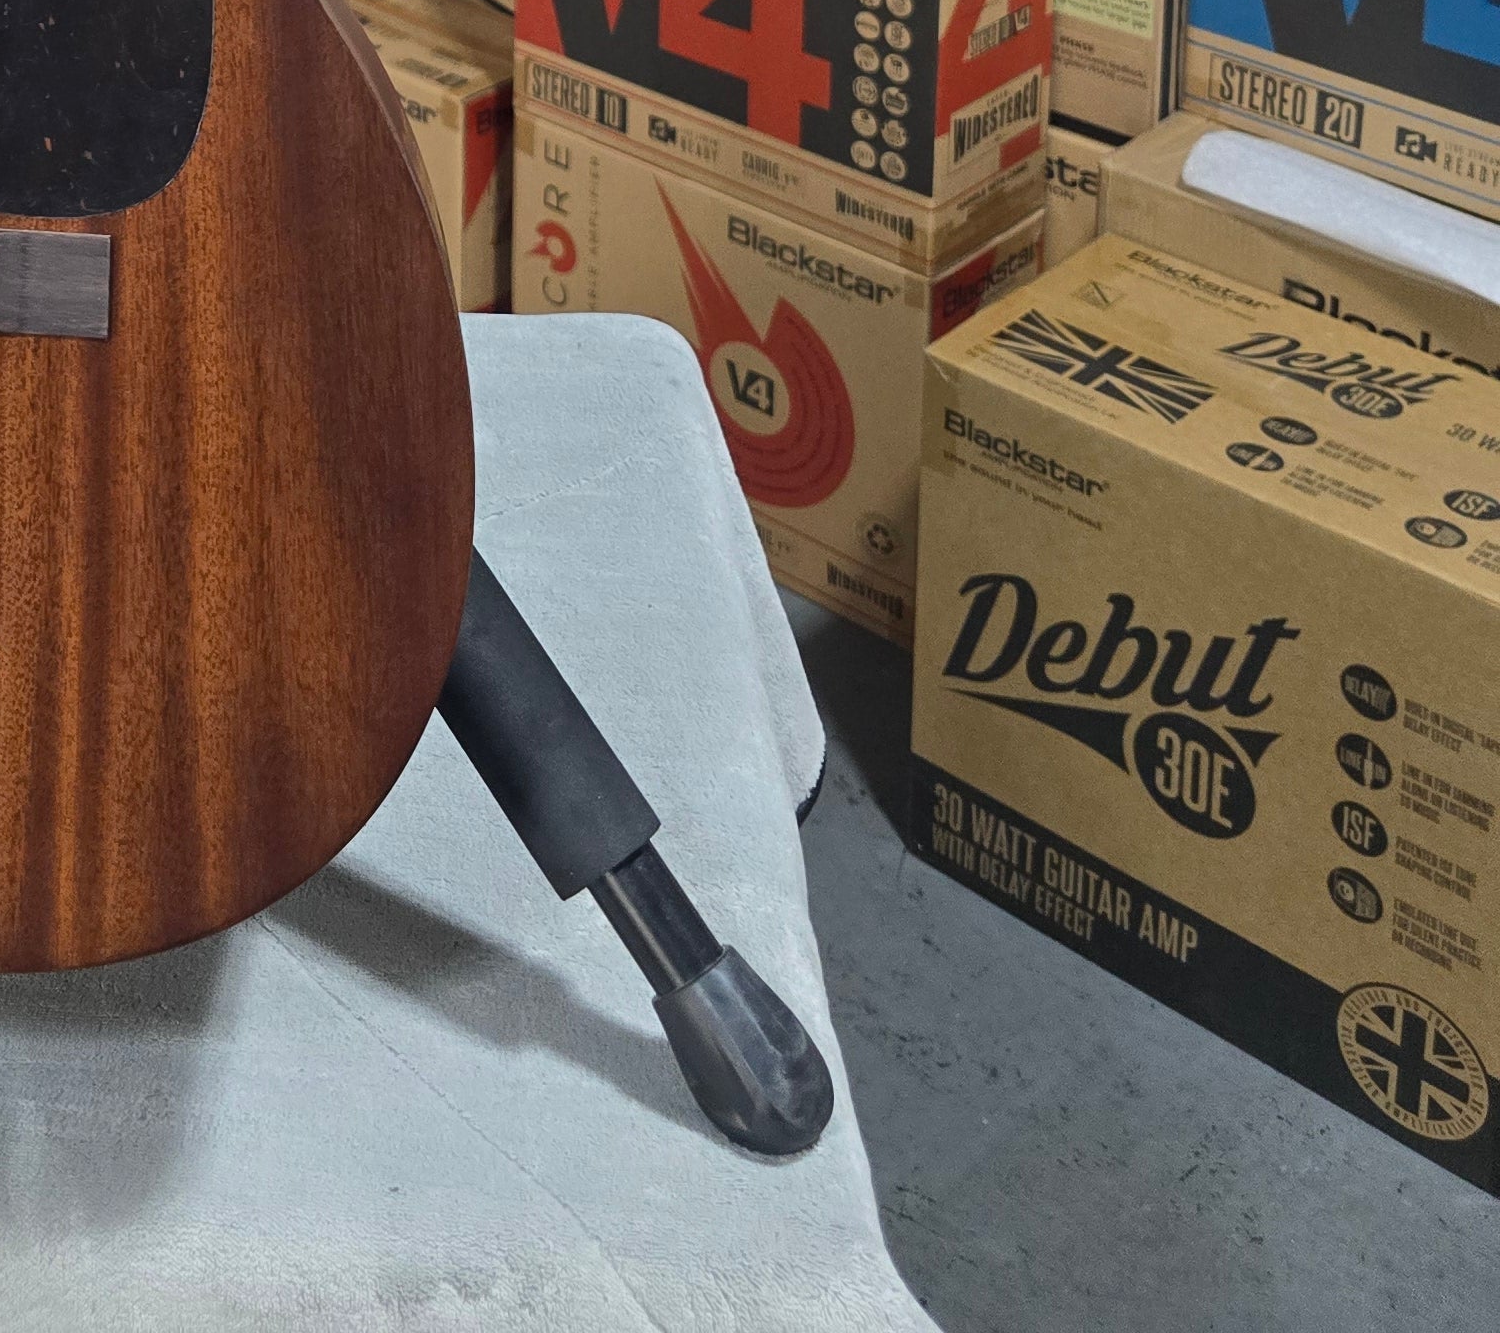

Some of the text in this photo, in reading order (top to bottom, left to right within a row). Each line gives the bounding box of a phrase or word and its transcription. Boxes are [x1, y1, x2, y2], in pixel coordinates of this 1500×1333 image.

[531, 65, 590, 119] STEREO
[1220, 60, 1358, 143] STEREO 20
[726, 214, 894, 306] Blackstar
[1127, 249, 1273, 311] Blackstar
[725, 358, 775, 418] V4
[1215, 332, 1461, 397] Debut
[943, 406, 1105, 498] Blackstar
[941, 572, 1302, 719] Debut
[1154, 726, 1235, 831] 30E
[1342, 805, 1377, 850] ISF
[931, 821, 1096, 942] WITH DELAY EFFECT
[932, 782, 1199, 964] 30 WATT GUITAR AMP
